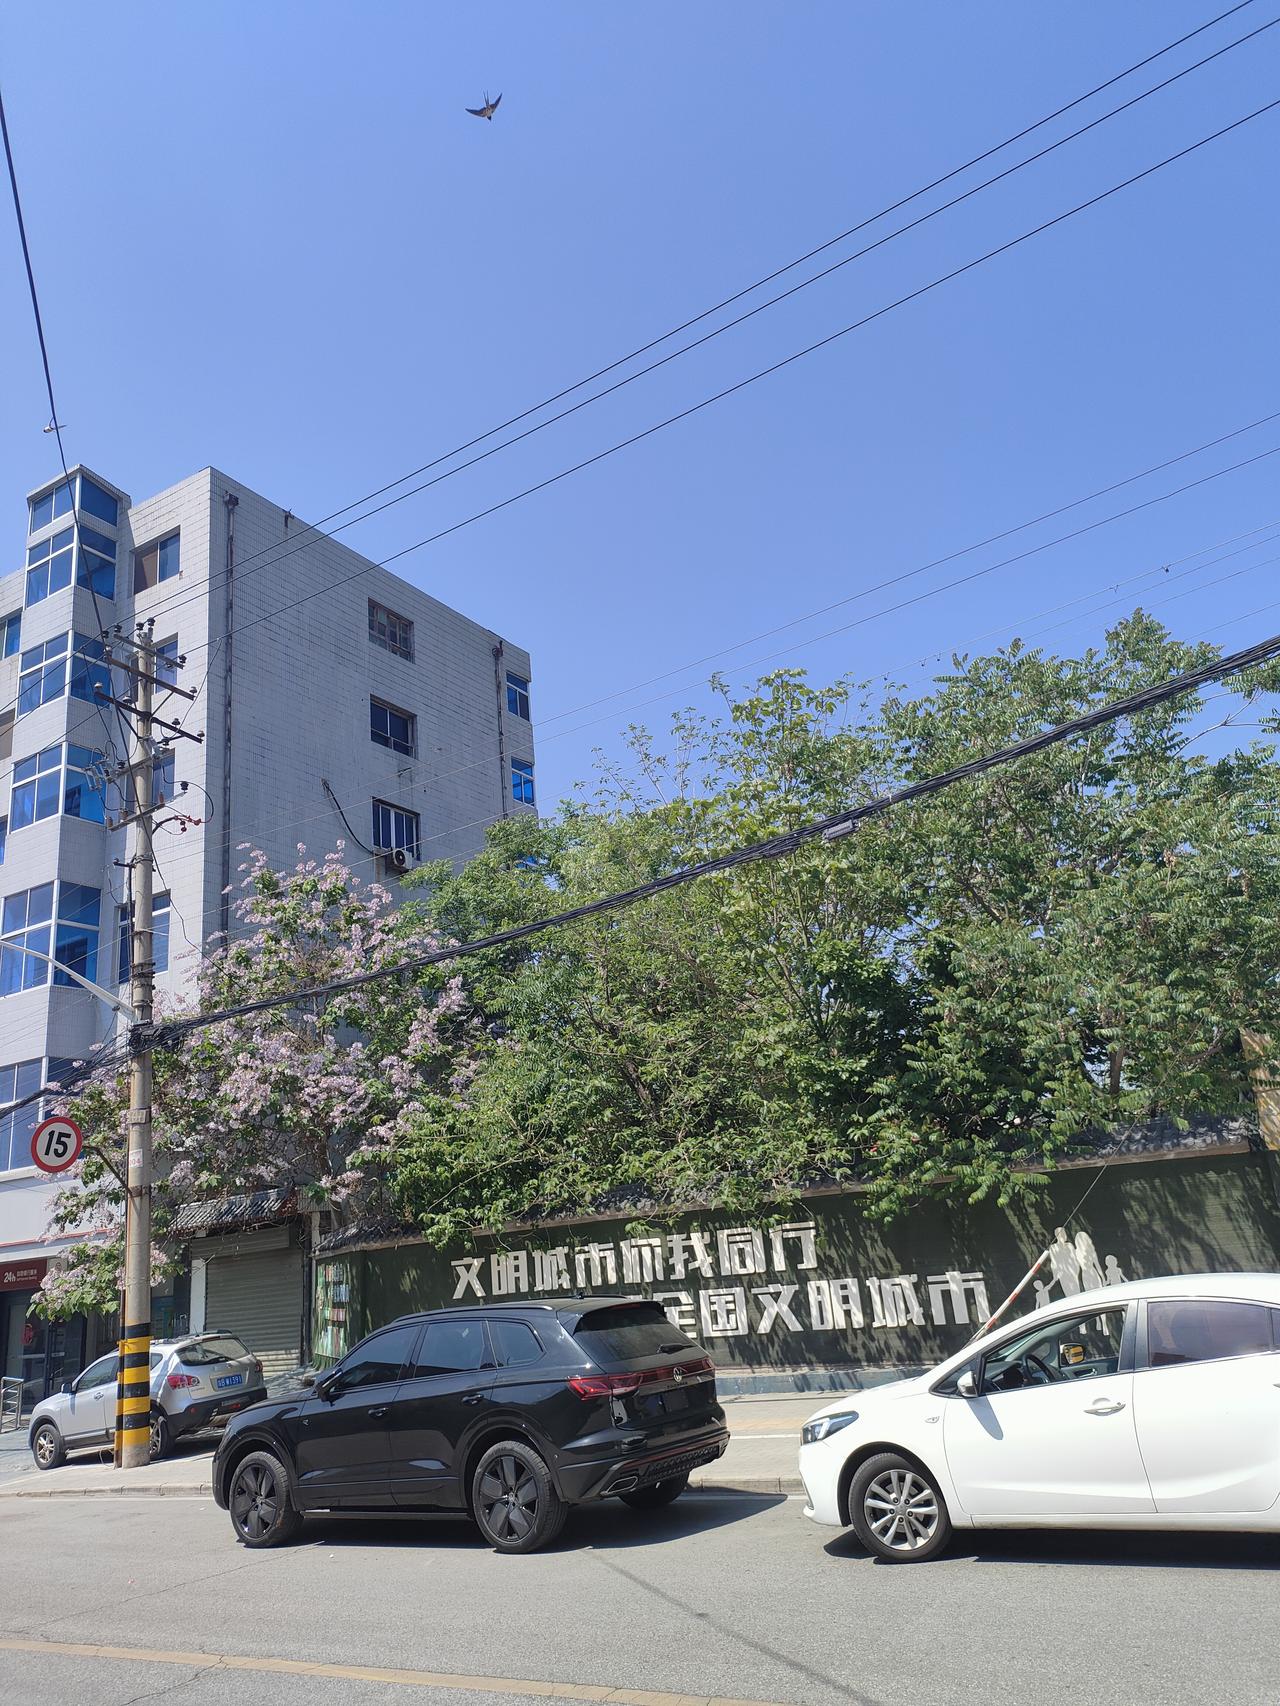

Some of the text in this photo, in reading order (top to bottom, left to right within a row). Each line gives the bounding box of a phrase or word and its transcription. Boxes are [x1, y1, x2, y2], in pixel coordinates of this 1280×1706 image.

[44, 1130, 72, 1158] 15
[3, 1271, 16, 1283] 24h
[627, 1270, 992, 1340] 全国文明城市
